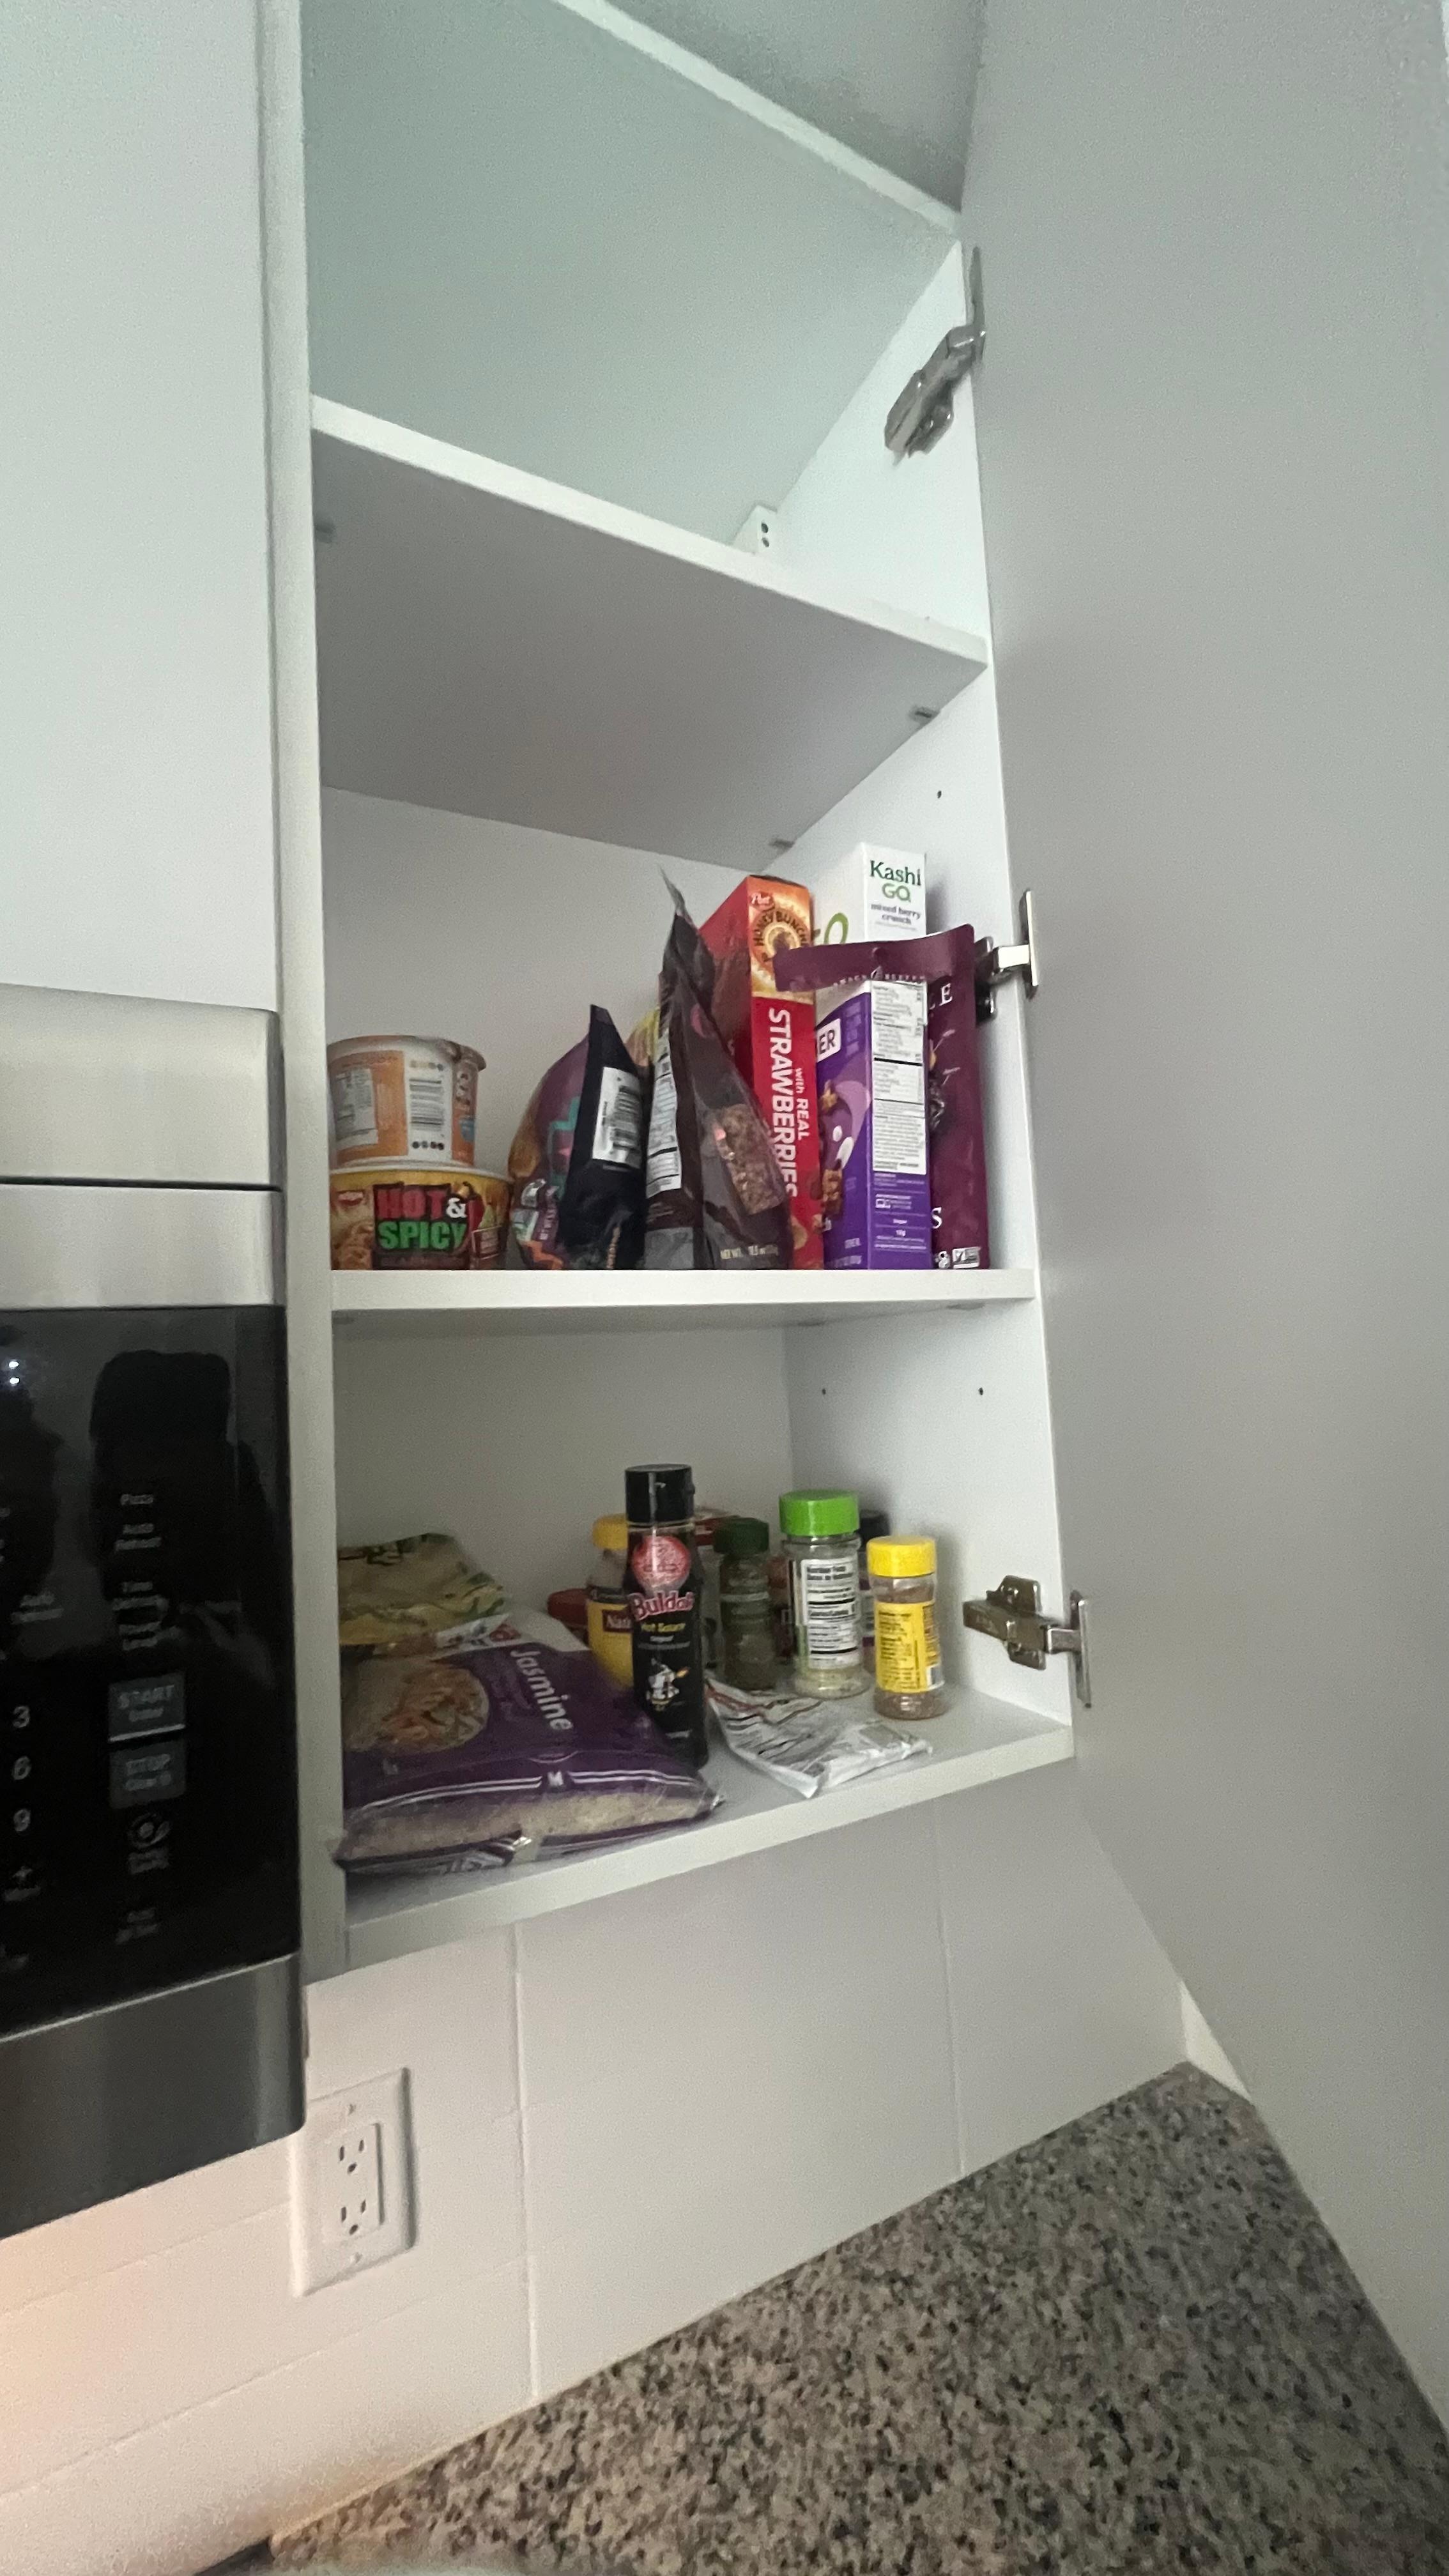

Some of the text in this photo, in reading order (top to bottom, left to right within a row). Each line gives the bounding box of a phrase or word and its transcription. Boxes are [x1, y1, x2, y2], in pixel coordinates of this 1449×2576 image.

[870, 860, 921, 886] Kashi
[797, 1098, 810, 1140] REAL
[377, 1188, 447, 1219] HOT
[378, 1220, 467, 1250] SPICY
[510, 1650, 574, 1730] Jasmine
[12, 1705, 31, 1729] 3
[12, 1755, 32, 1781] 6
